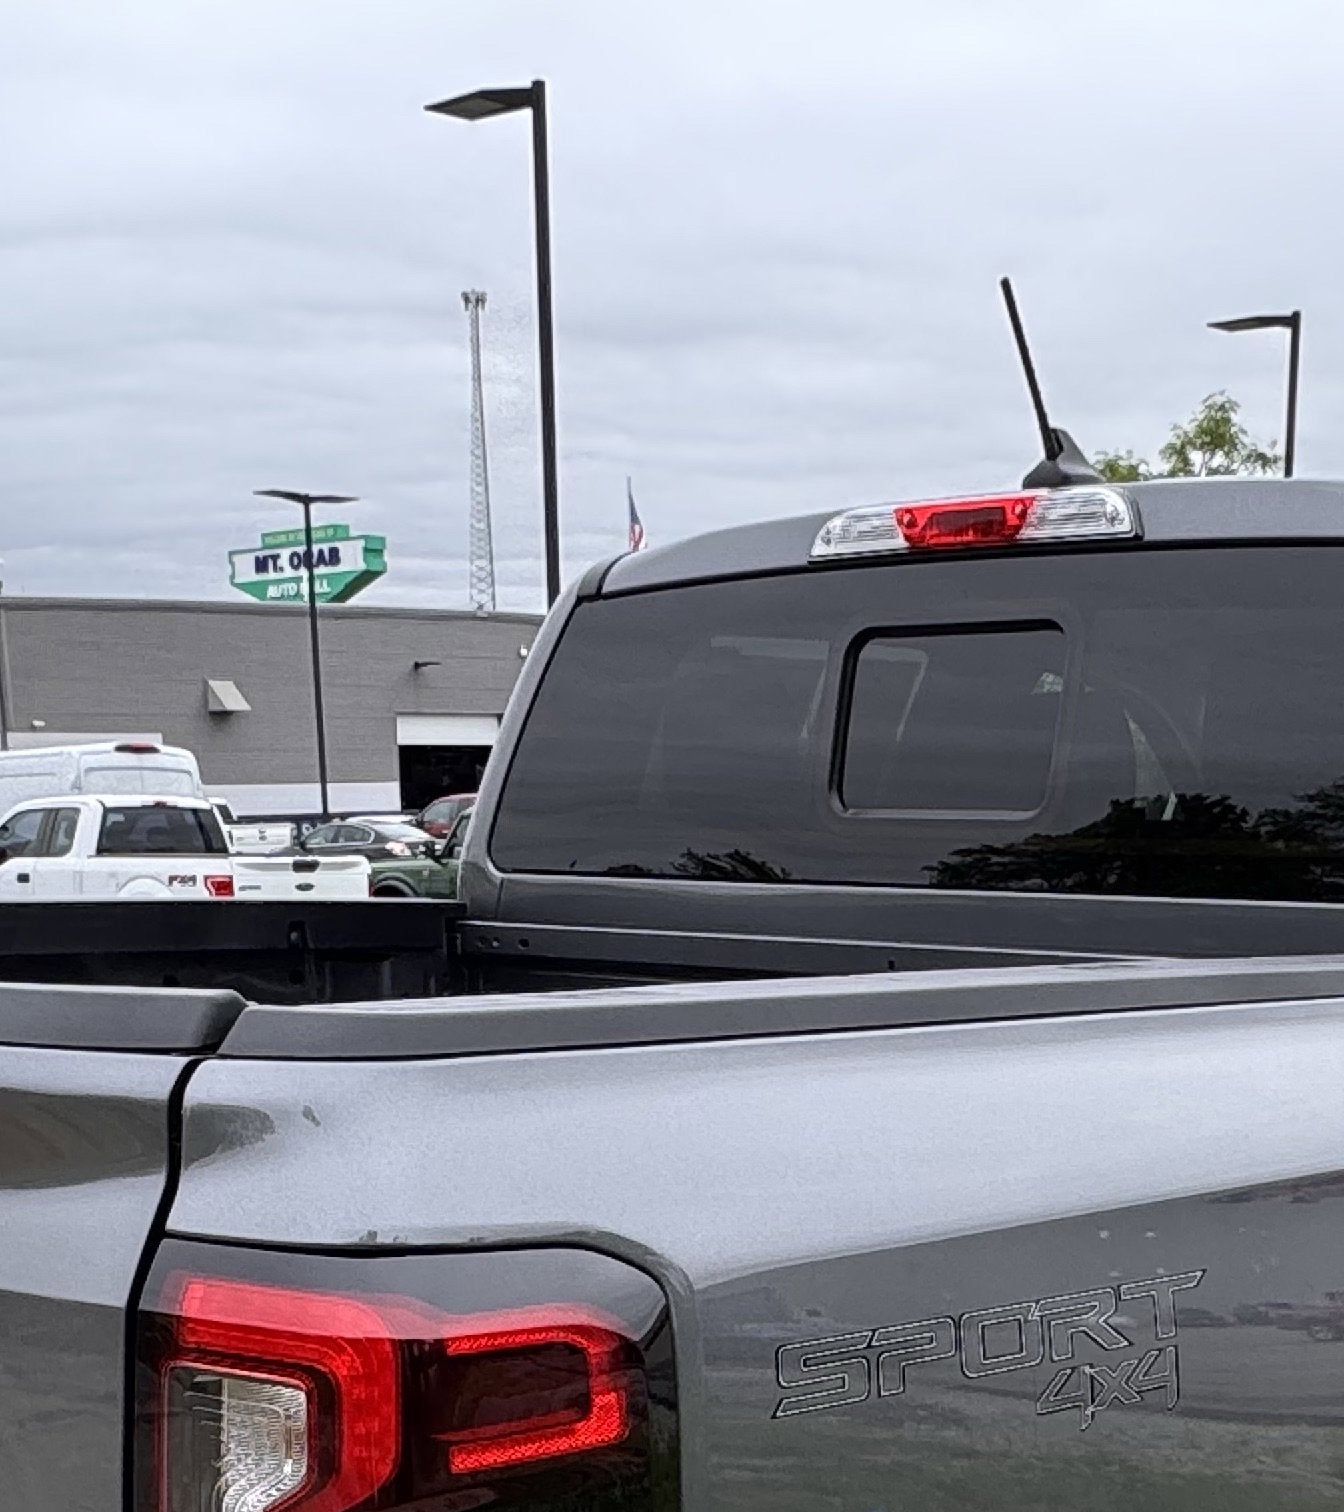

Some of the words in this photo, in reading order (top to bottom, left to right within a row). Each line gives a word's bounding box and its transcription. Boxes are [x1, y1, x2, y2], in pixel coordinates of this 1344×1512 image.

[254, 553, 284, 574] MT.
[267, 582, 298, 598] AUTO
[770, 1269, 1207, 1419] SPORT
